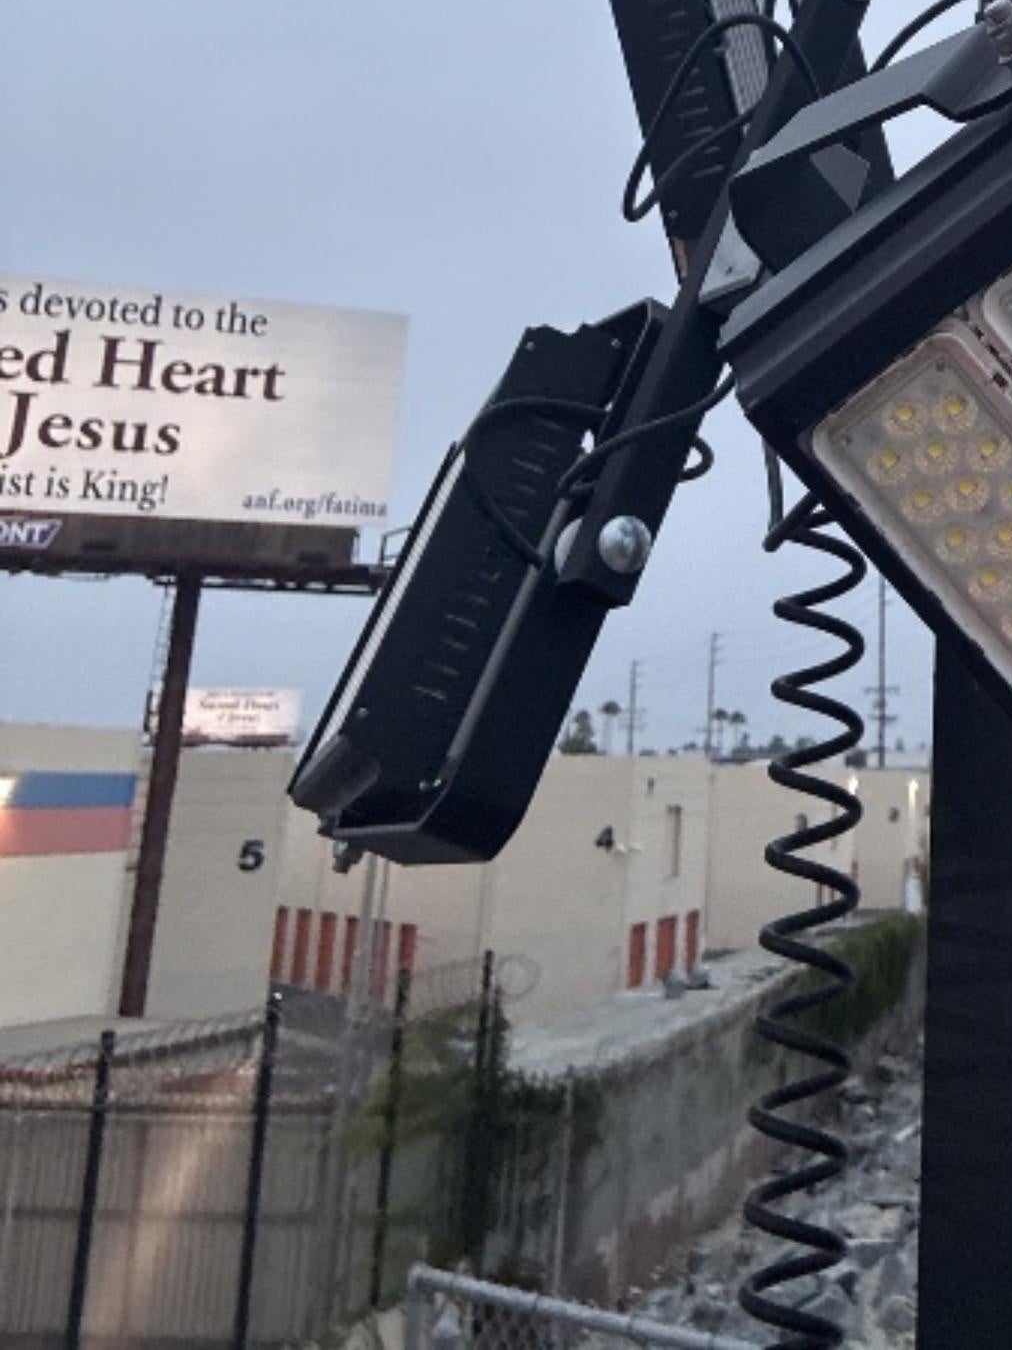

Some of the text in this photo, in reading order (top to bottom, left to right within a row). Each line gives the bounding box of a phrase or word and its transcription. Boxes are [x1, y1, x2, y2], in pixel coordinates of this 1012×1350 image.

[19, 283, 163, 327] devoted
[172, 304, 205, 331] to
[215, 302, 268, 336] the
[92, 334, 287, 401] Heart
[0, 390, 181, 459] Jesus
[44, 466, 70, 499] is
[79, 468, 168, 511] King!
[238, 840, 264, 872] 5
[595, 824, 614, 852] 4
